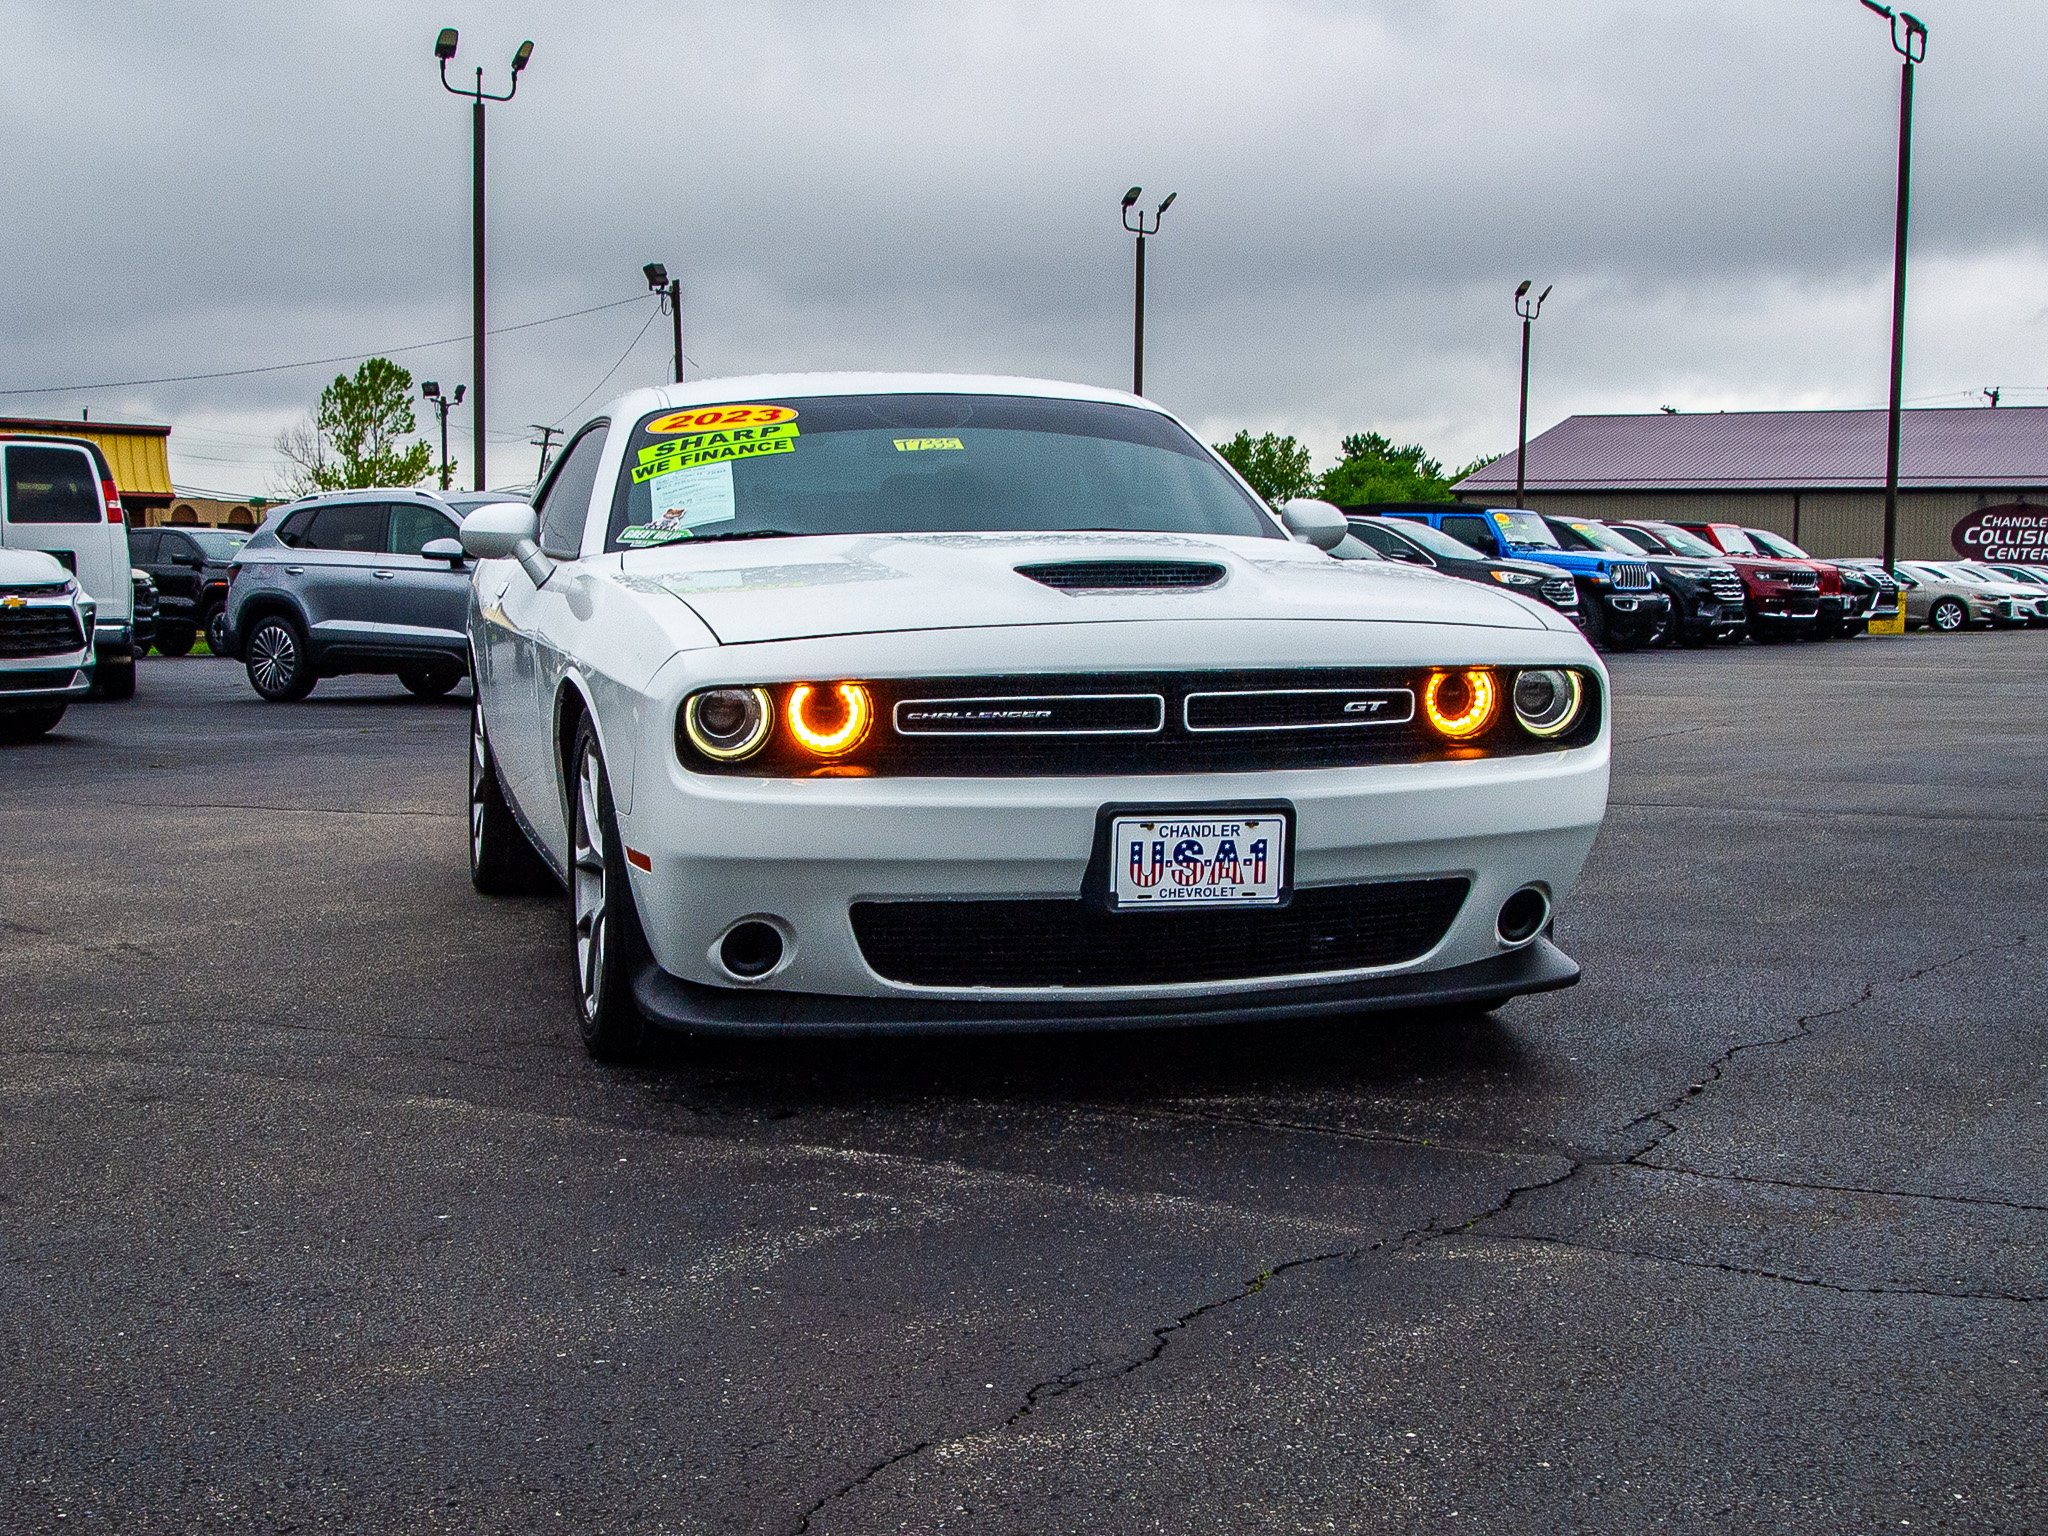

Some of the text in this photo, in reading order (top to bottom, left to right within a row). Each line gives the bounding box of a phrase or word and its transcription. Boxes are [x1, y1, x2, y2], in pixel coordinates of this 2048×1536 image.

[662, 409, 783, 431] 2023
[654, 426, 781, 457] SHARP
[635, 440, 788, 479] WE FINANCE
[1344, 700, 1388, 712] GT
[907, 710, 1052, 720] CHALLENGER
[1159, 824, 1241, 838] CHANDLER
[1159, 886, 1237, 899] CHEVROLET
